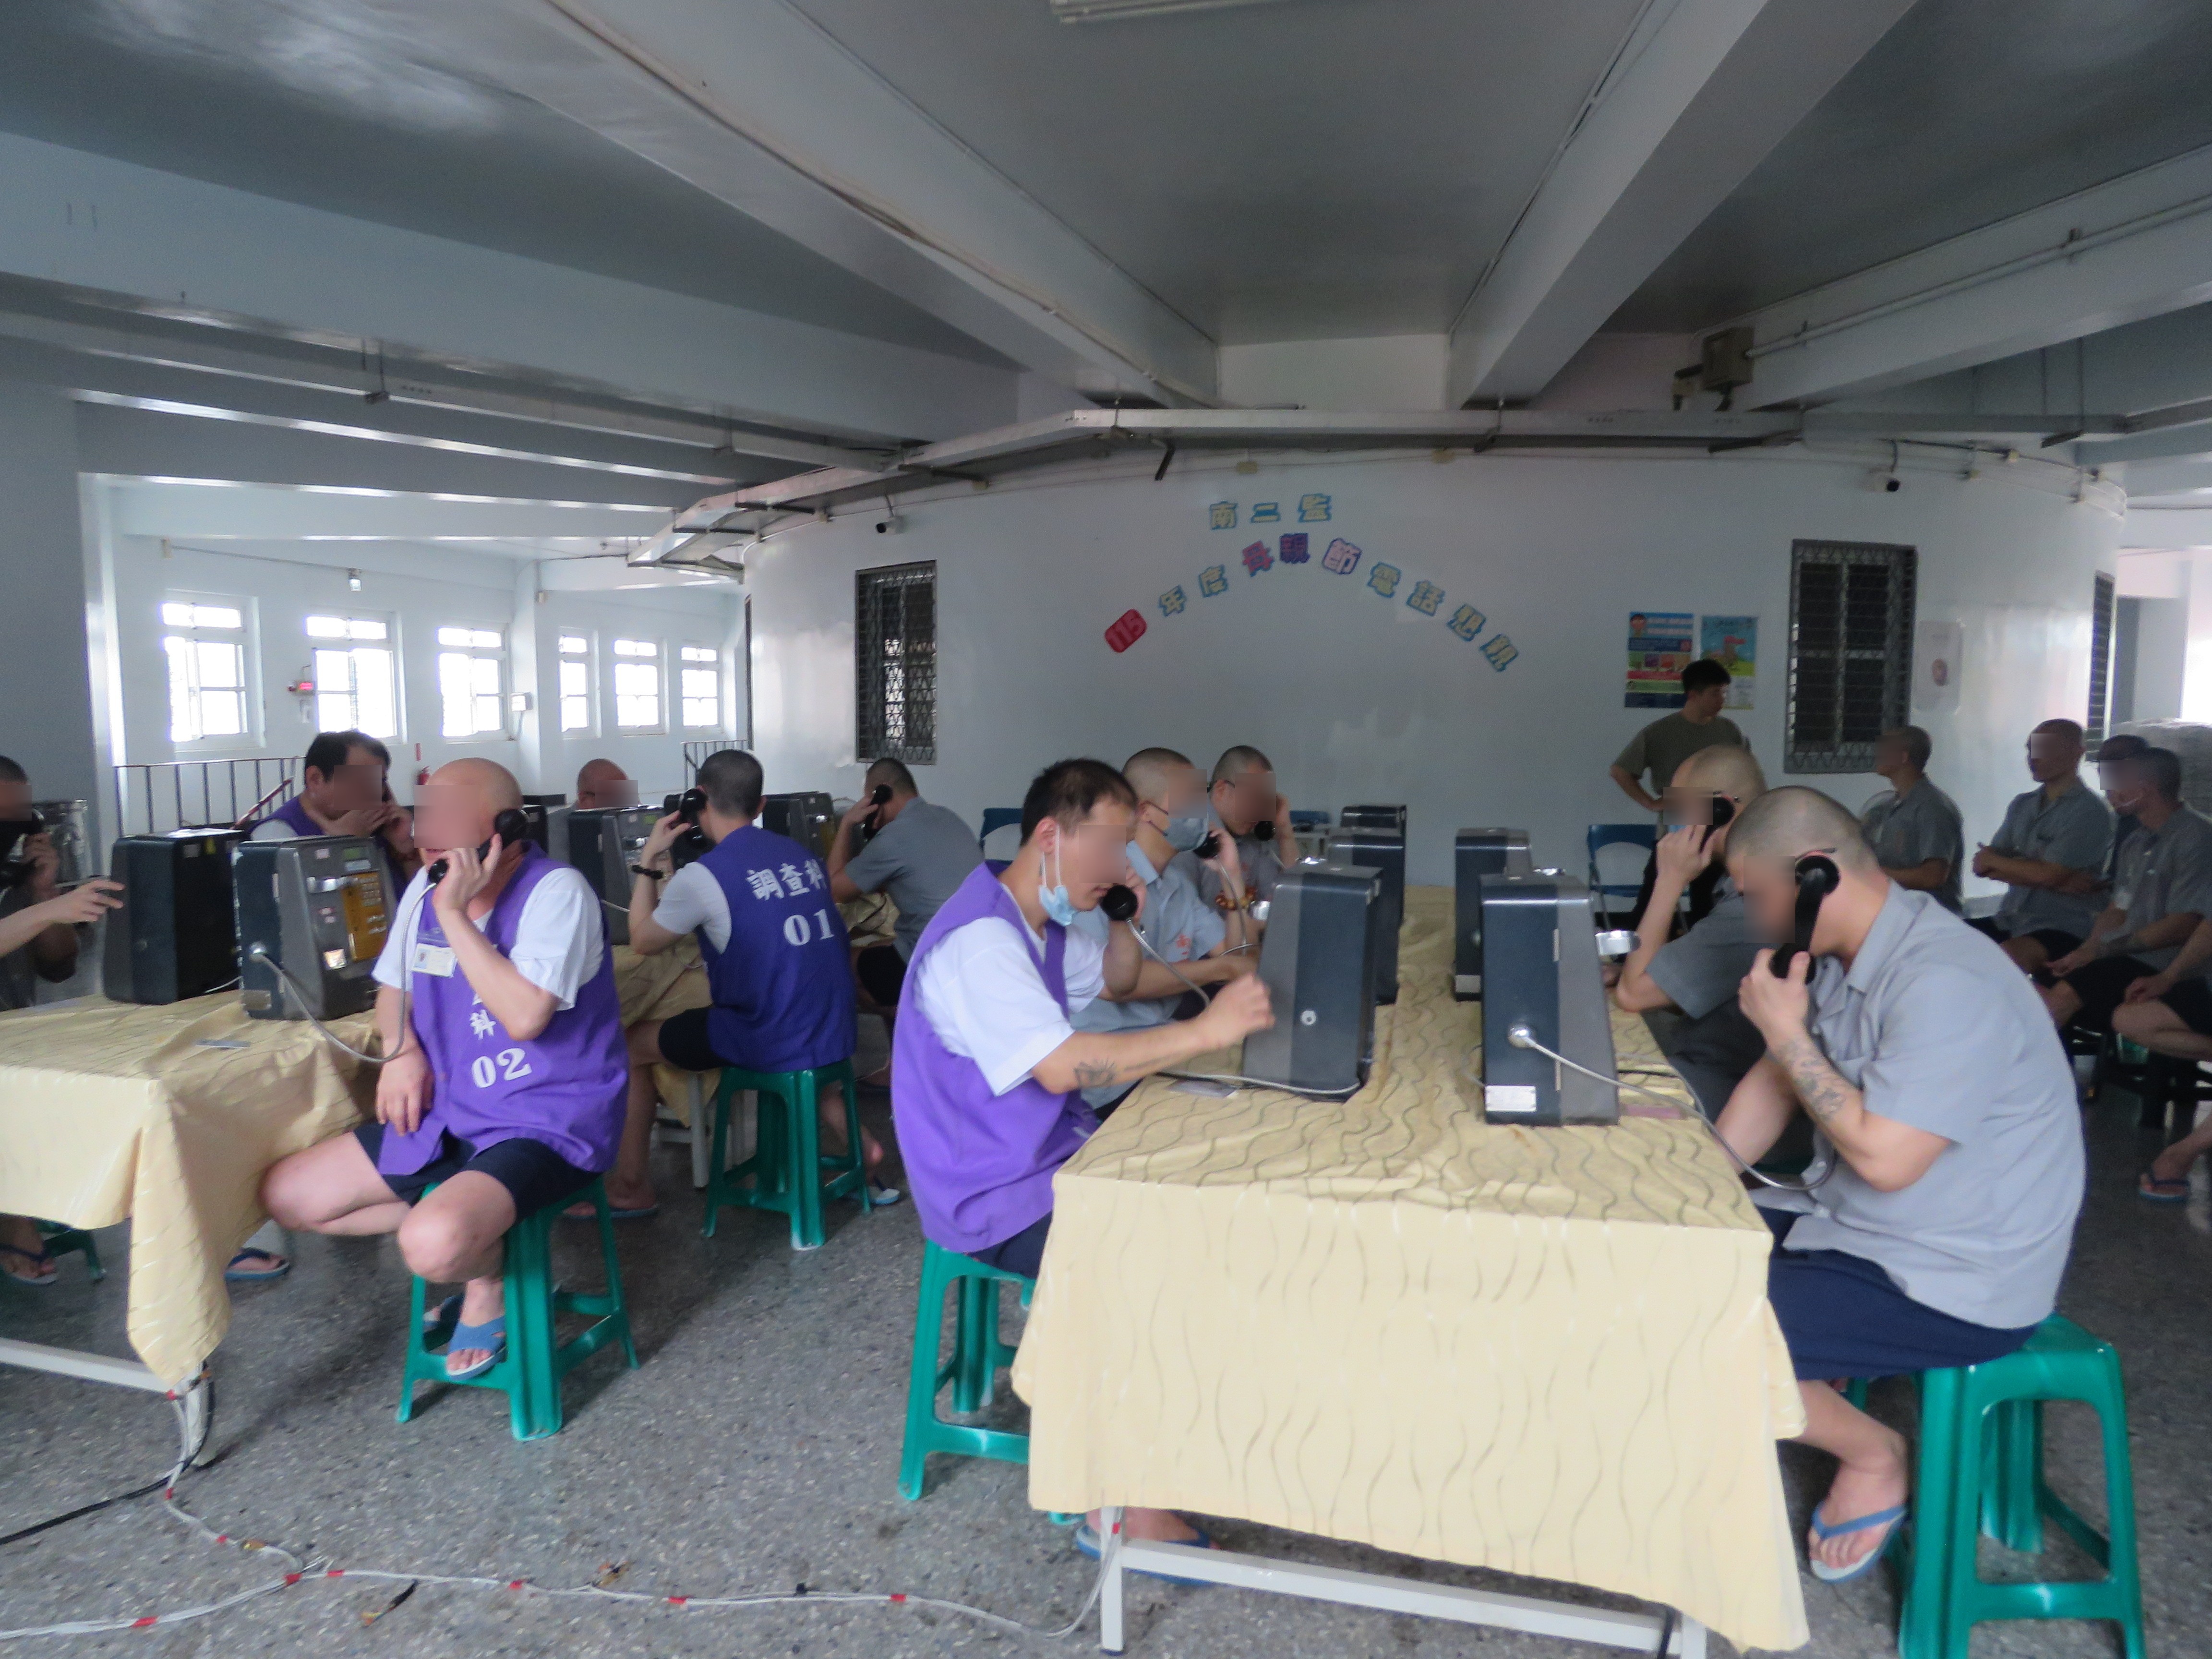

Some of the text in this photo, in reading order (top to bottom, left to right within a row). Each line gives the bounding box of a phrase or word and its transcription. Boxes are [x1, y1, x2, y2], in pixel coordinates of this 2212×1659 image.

[1209, 493, 1333, 530] 南二監
[783, 909, 834, 946] 01
[471, 1047, 533, 1088] 02
